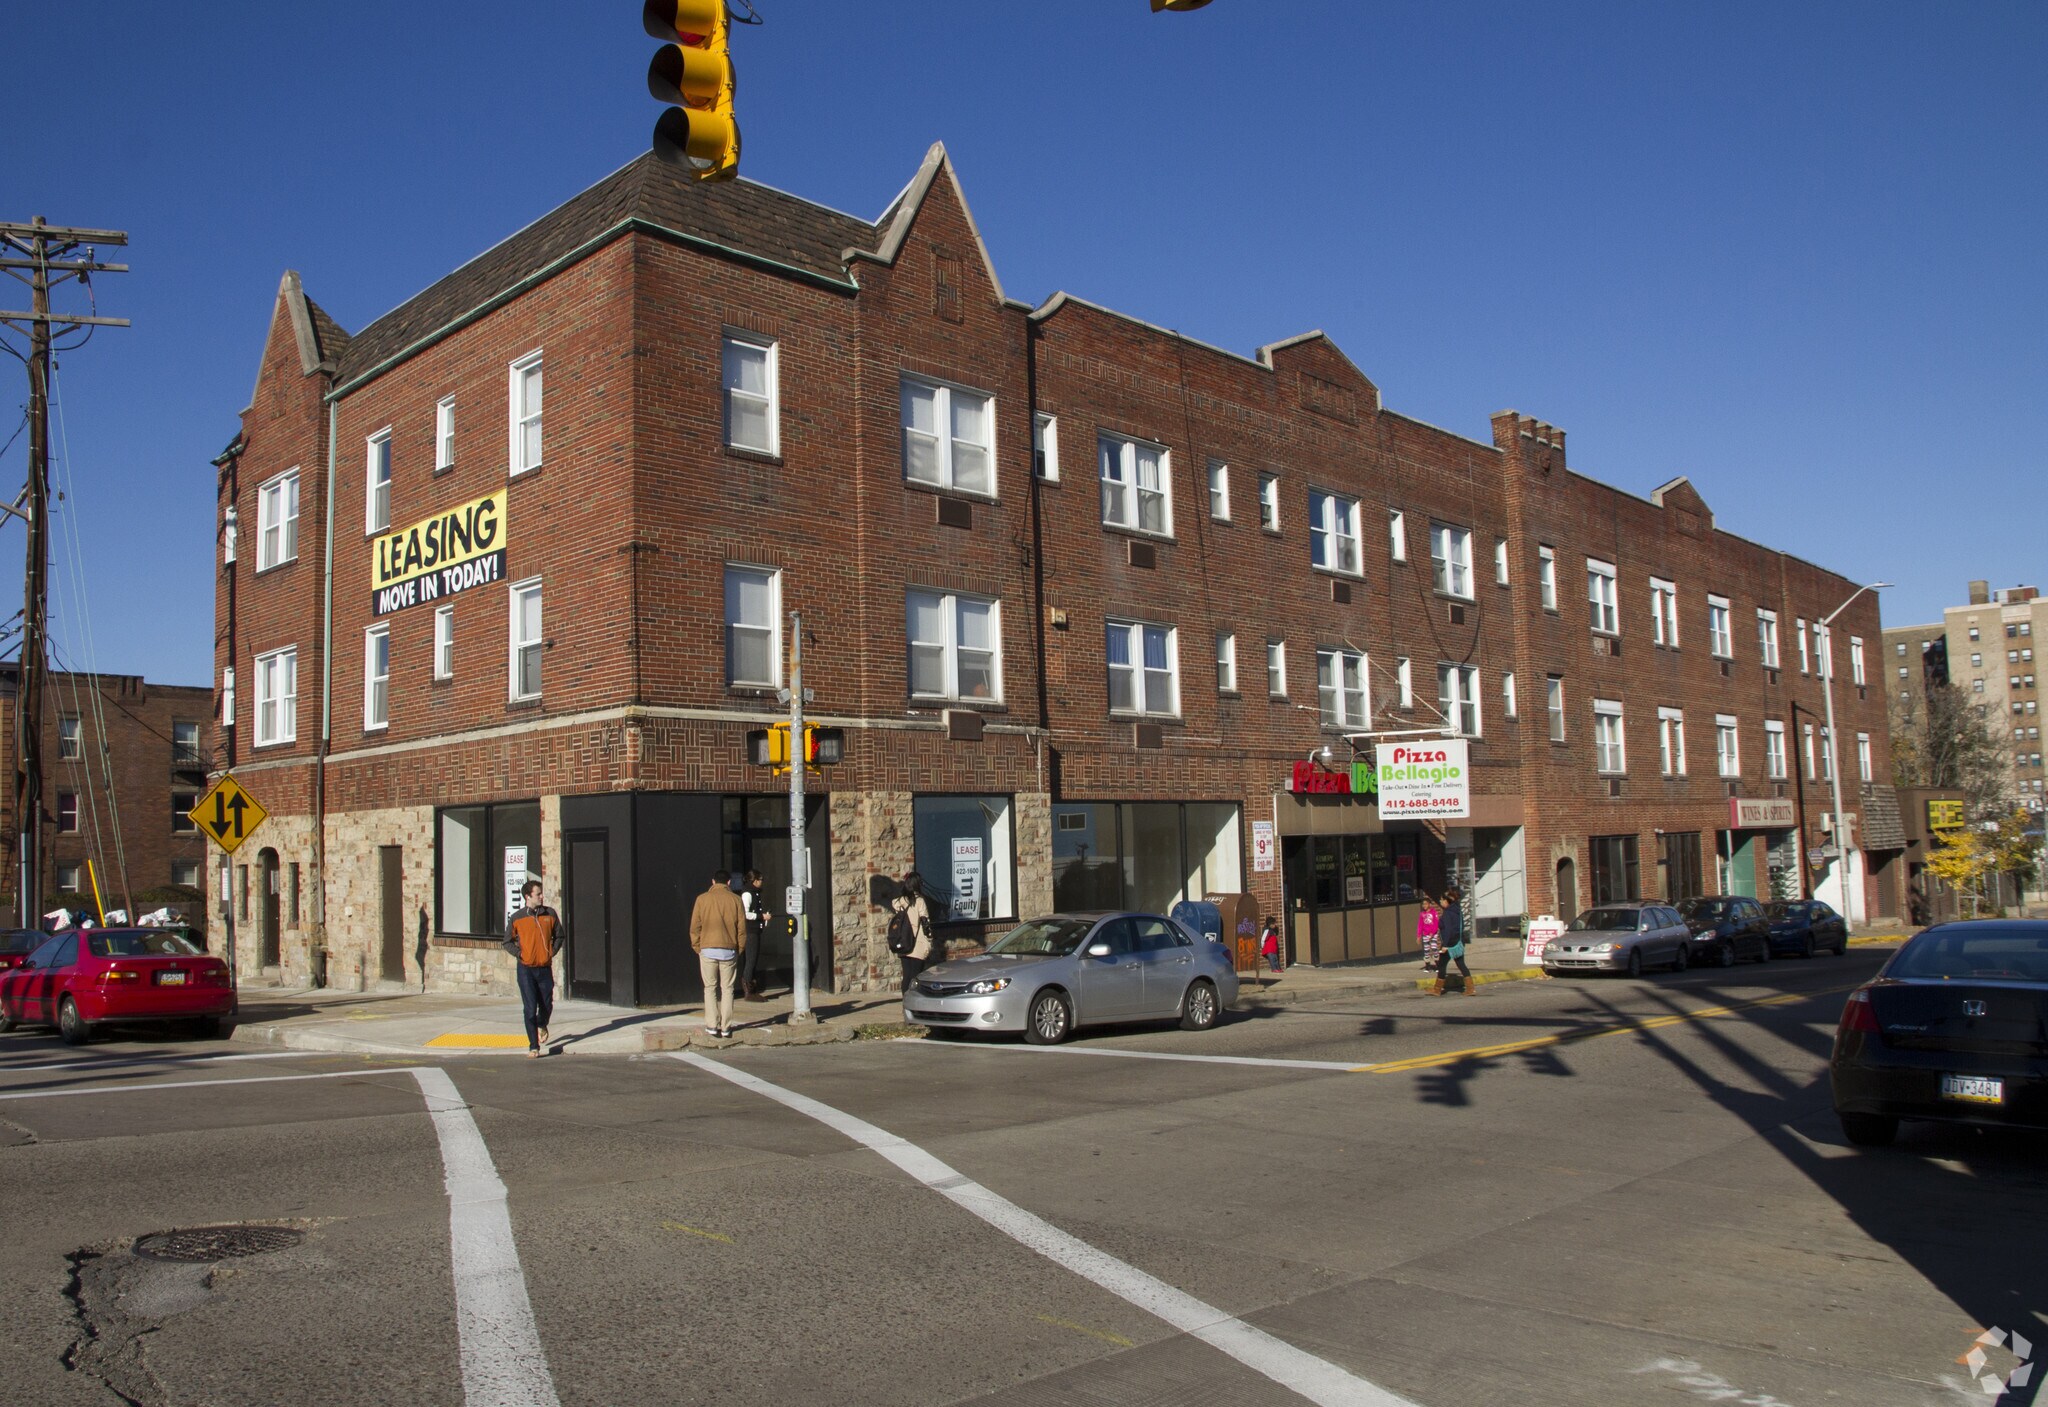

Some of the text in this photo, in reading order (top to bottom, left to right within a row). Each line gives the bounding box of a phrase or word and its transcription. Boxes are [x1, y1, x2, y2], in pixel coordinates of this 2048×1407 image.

[379, 498, 498, 583] LEASING
[379, 554, 498, 615] MOVE IN TODAY!
[1393, 747, 1447, 764] Pizza
[1381, 763, 1461, 783] Bellagio
[1386, 798, 1459, 808] 412-688-8448
[1382, 808, 1464, 816] www.pizzabellagio.com
[1741, 806, 1792, 821] WINES & SPIRITS
[956, 845, 979, 855] LEASE
[506, 854, 524, 864] LEASE
[956, 867, 979, 875] 422-1600
[954, 899, 978, 912] Equity
